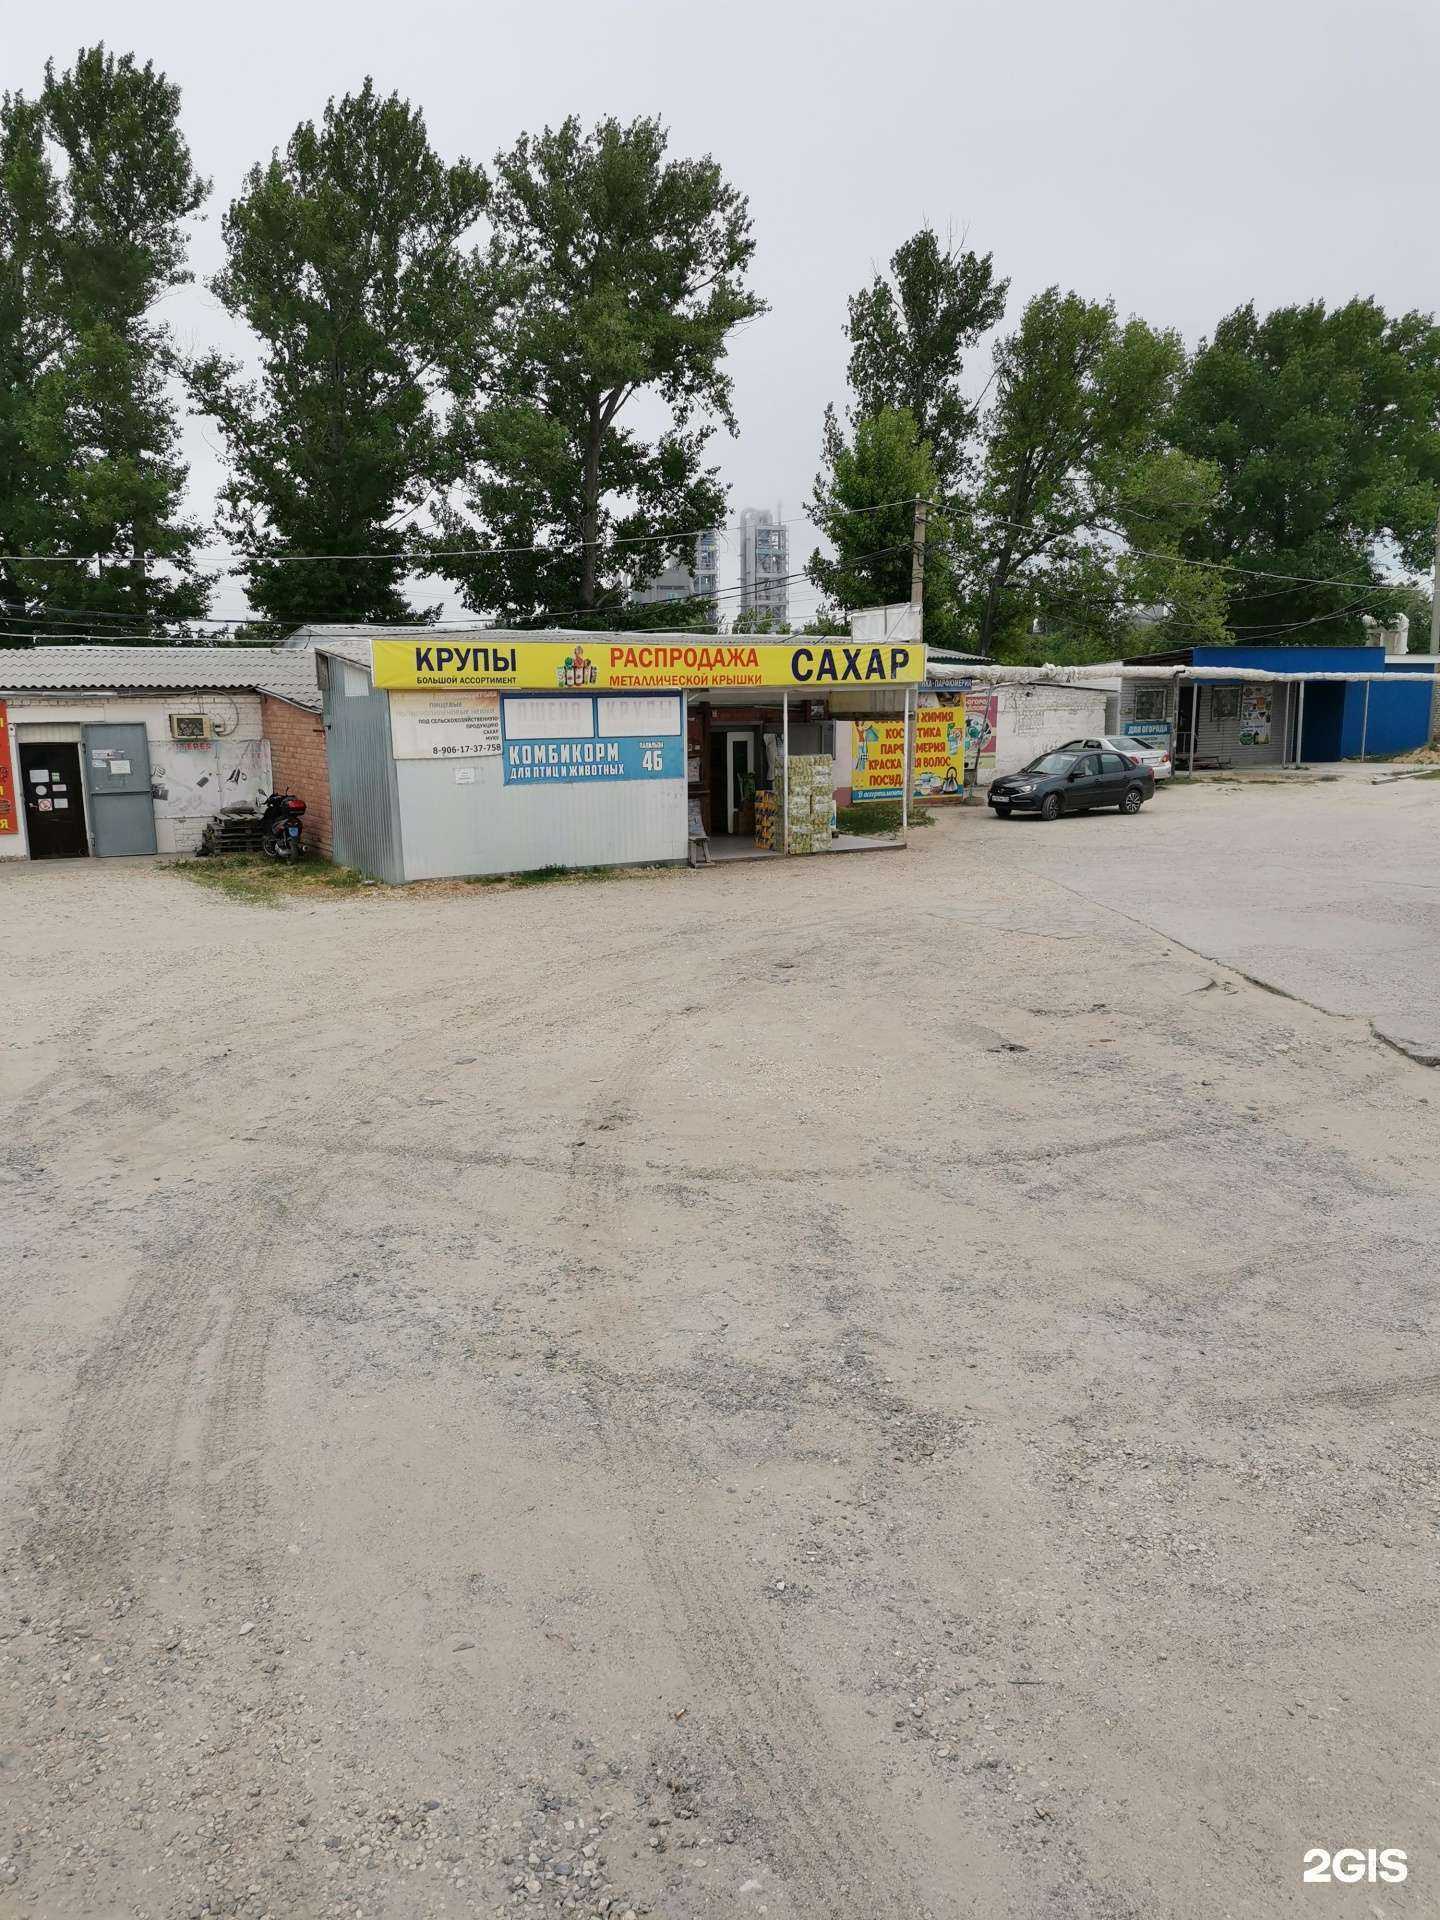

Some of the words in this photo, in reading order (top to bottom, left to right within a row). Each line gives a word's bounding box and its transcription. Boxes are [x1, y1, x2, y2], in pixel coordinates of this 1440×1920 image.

[416, 647, 517, 672] КРУПЫ
[610, 647, 759, 671] РАСПРОДАЖА
[791, 648, 910, 682] САХАР
[417, 676, 458, 685] БОЛЬШОЙ
[460, 676, 517, 685] АССОРТИМЕНТ
[609, 673, 708, 687] МЕТАЛЛИЧЕСКОЙ
[711, 674, 762, 686] КРЫШКИ
[432, 743, 501, 755] 8-906-17-37-758
[509, 743, 619, 765] КОМБИКОРМ
[642, 750, 663, 771] 46
[868, 760, 903, 772] КРАСКА
[923, 756, 952, 768] ВОЛОС
[511, 768, 531, 780] ДЛЯ
[533, 767, 560, 779] ПТИЦ
[561, 767, 567, 777] И
[569, 764, 625, 777] ЖИВОТНЫХ
